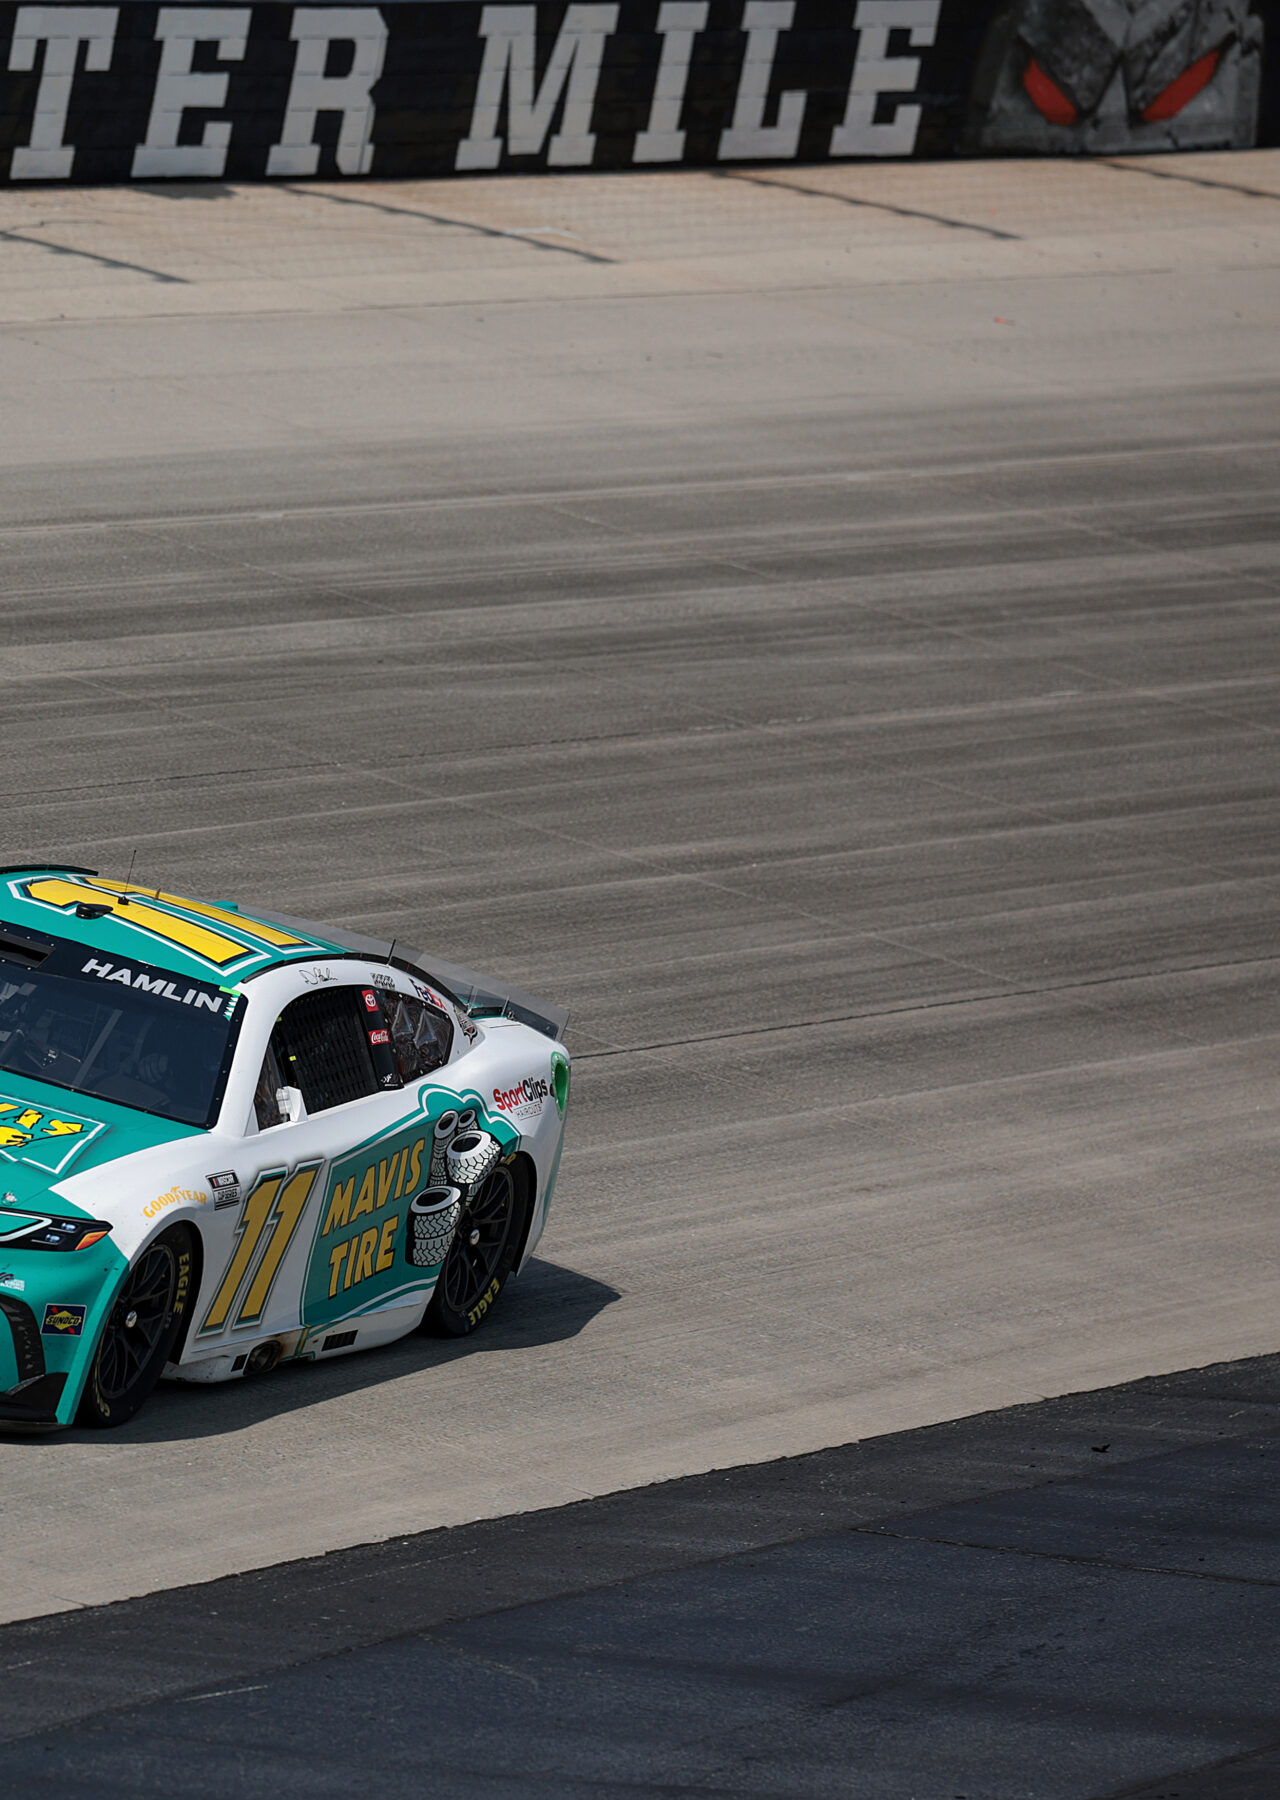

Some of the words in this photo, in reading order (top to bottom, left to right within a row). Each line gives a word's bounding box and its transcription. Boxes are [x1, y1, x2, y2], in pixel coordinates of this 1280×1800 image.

[455, 0, 939, 169] MILE
[81, 958, 223, 1013] HAMLIN
[143, 1186, 207, 1218] GOODYEAR
[321, 1137, 426, 1238] MAVIS
[199, 1161, 324, 1334] 11
[327, 1214, 399, 1300] TIRE
[173, 1252, 190, 1315] EAGLE
[468, 1277, 500, 1325] EAGLE
[47, 1315, 81, 1326] SUNOCO
